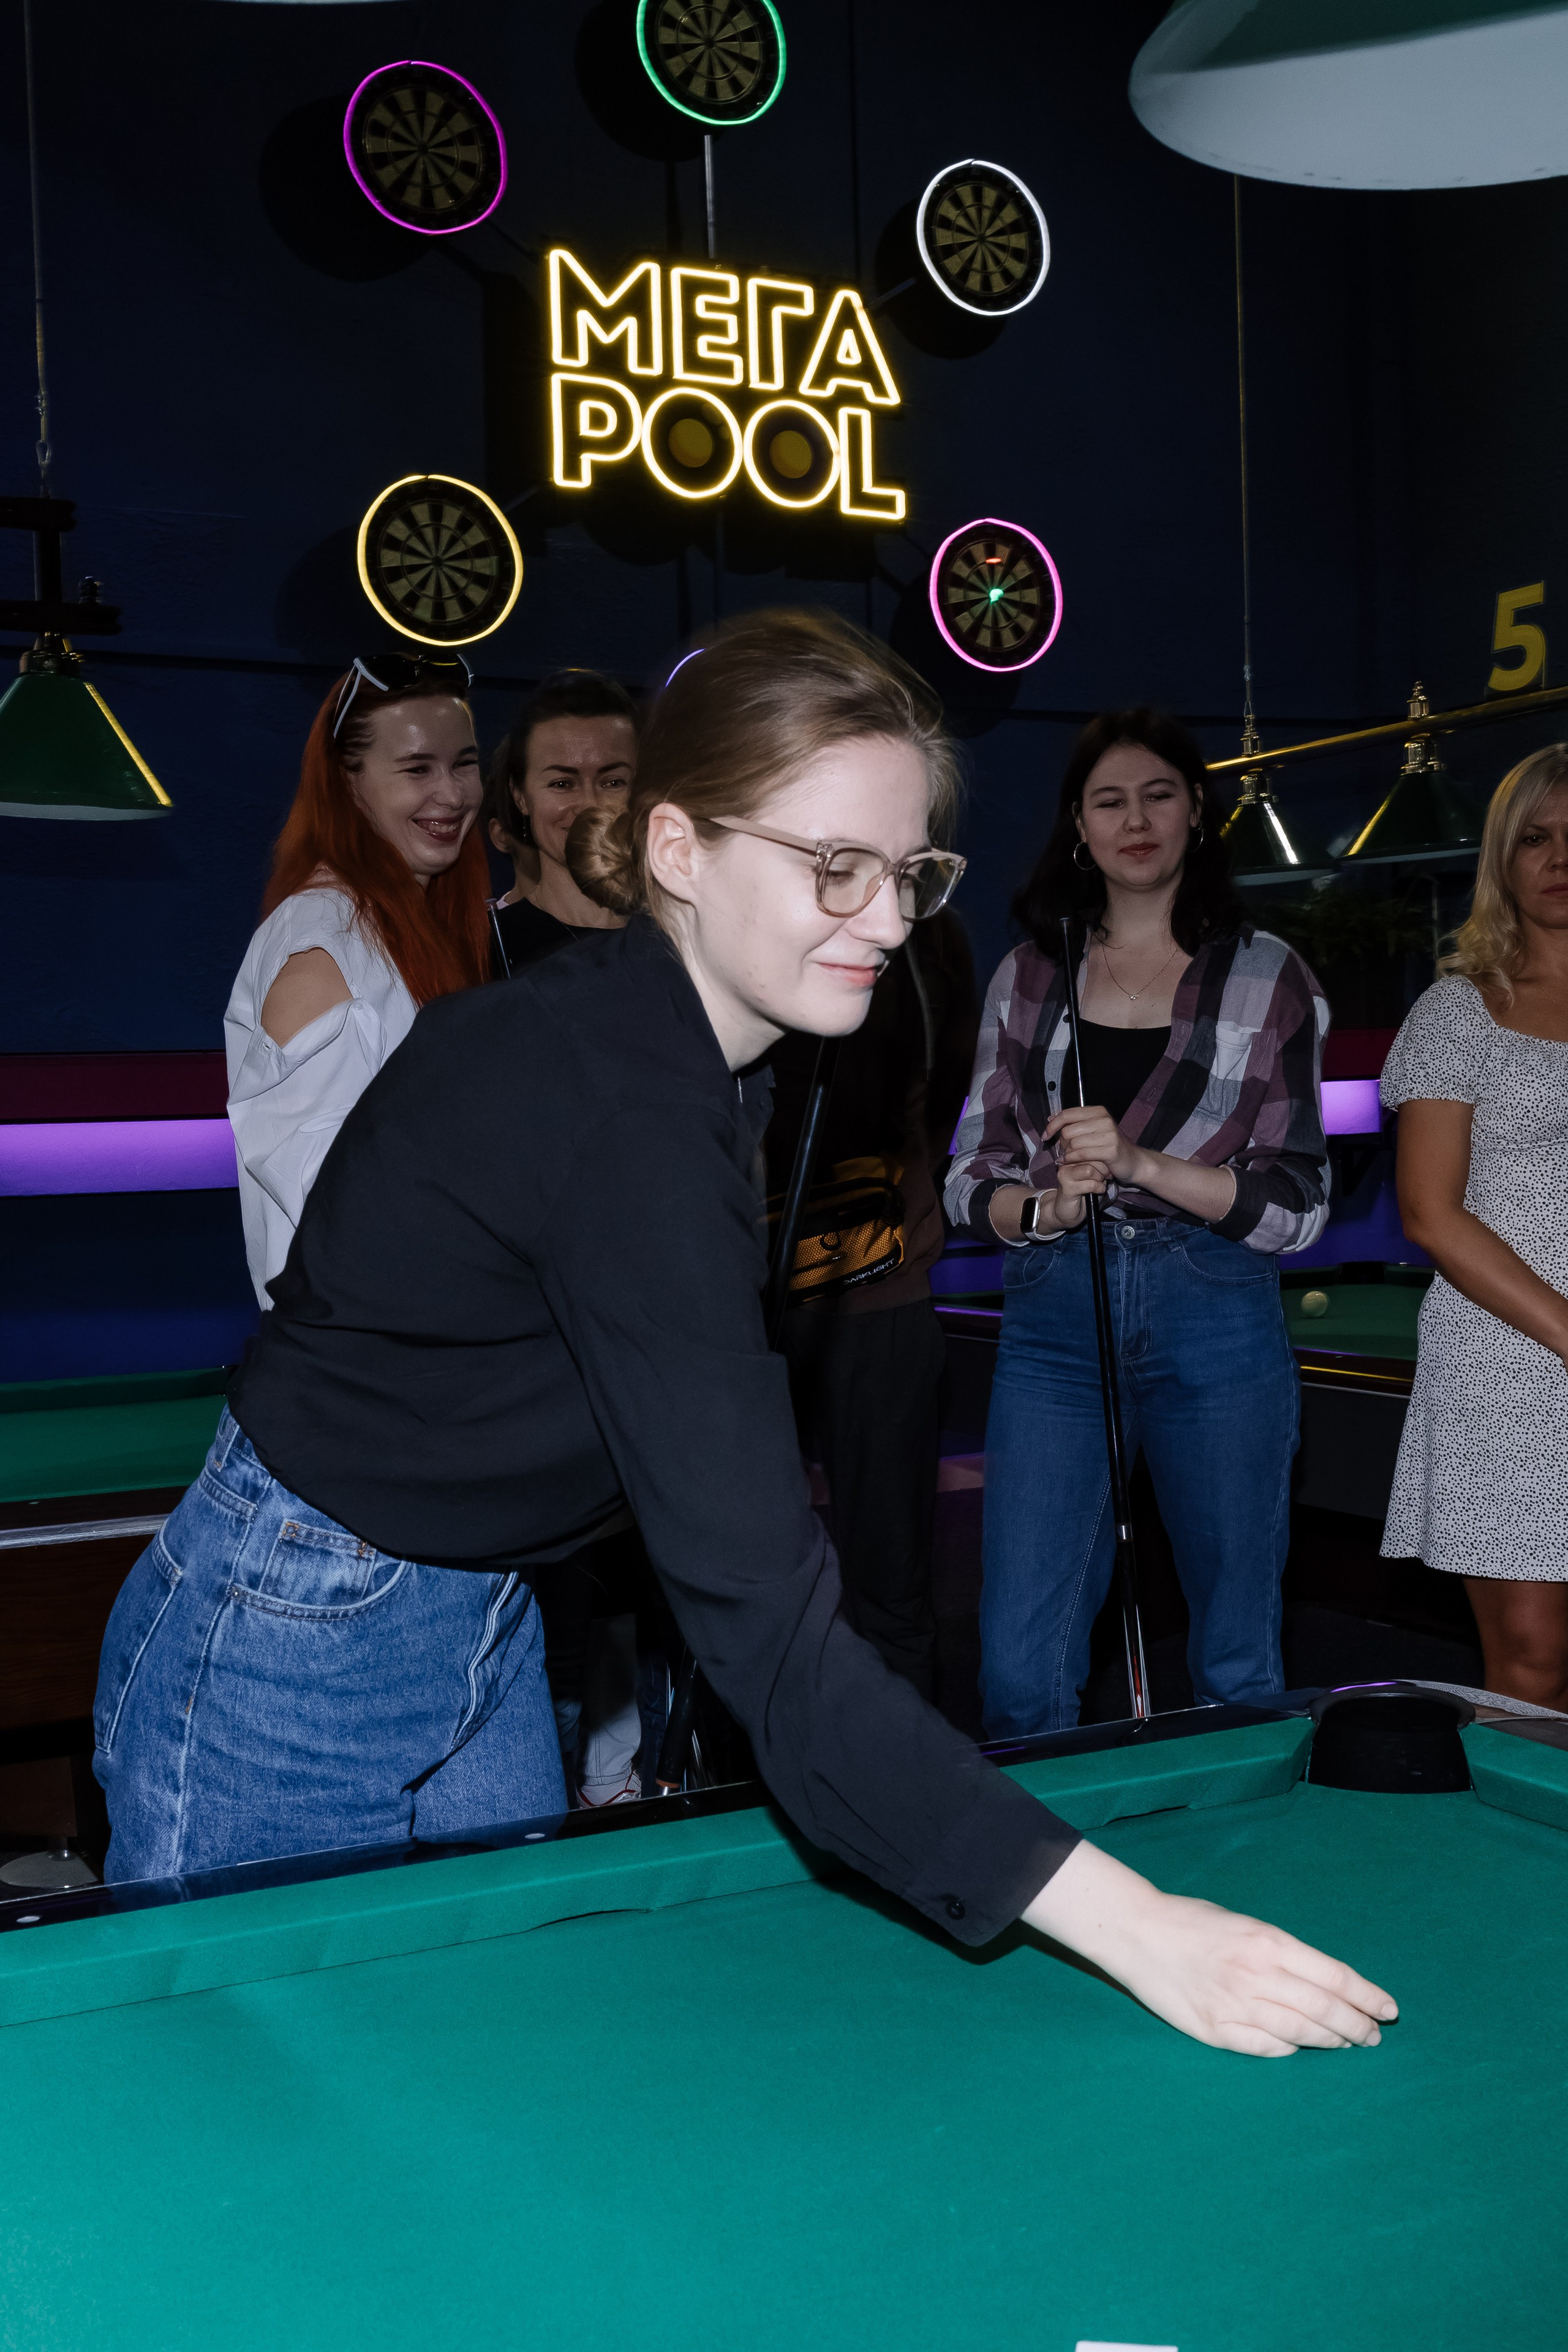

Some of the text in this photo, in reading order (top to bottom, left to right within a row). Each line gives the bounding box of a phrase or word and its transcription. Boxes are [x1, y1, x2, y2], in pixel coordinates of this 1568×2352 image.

[549, 249, 901, 405] МЕГА
[551, 372, 906, 520] POOL
[1487, 581, 1546, 692] 5
[843, 1257, 895, 1286] DARKLIGHT
